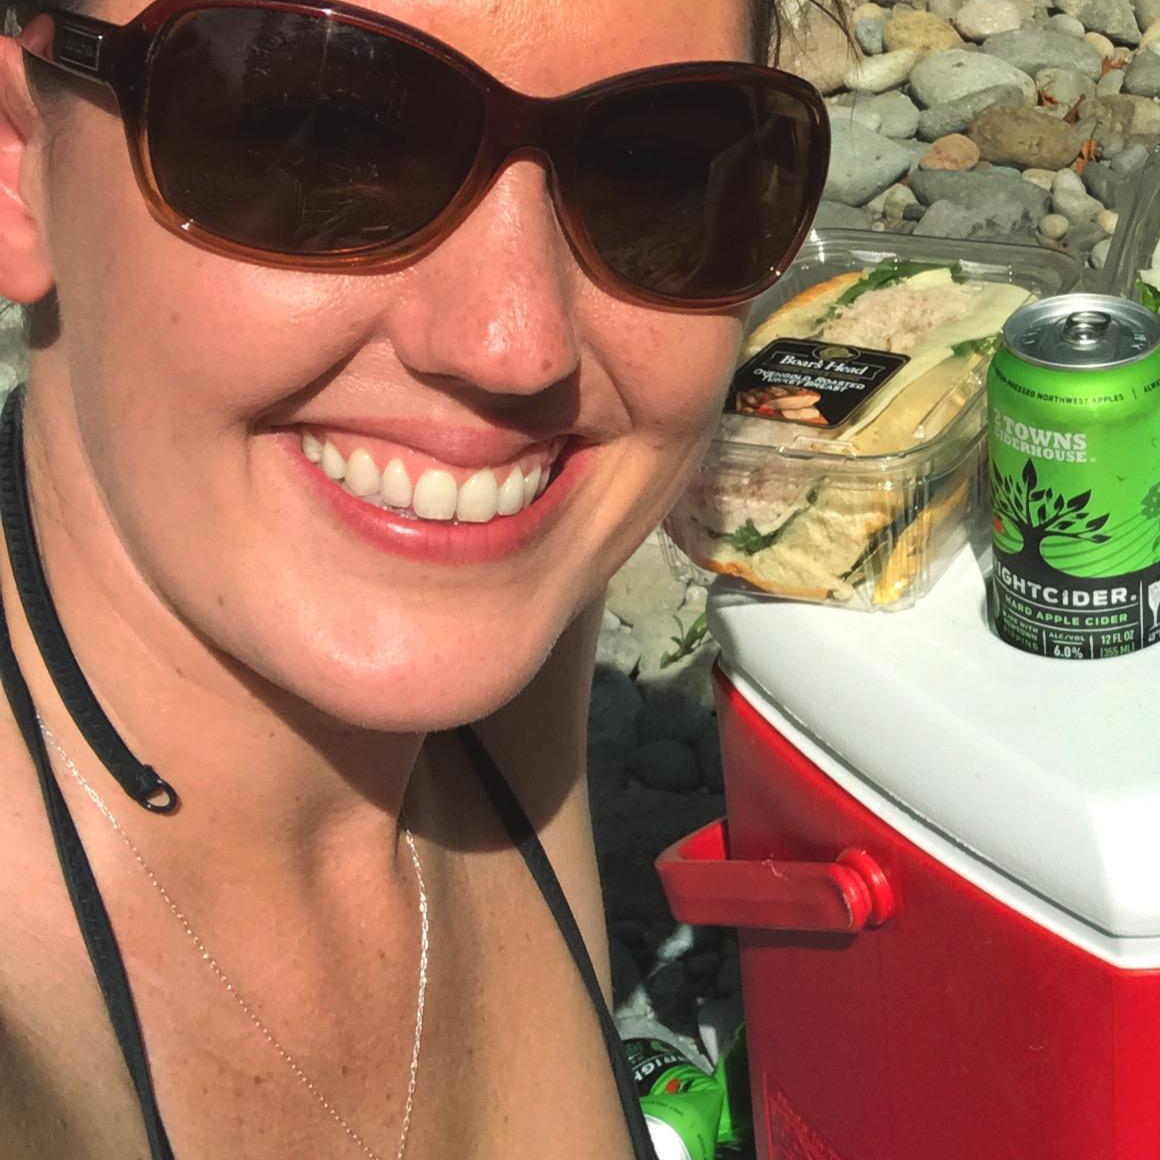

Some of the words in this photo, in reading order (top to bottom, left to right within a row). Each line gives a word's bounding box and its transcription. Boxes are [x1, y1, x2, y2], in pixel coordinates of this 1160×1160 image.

[824, 361, 869, 375] Head
[1037, 393, 1089, 405] NORTHWEST
[1092, 393, 1125, 404] APPLES
[1003, 415, 1087, 450] TOWNS
[993, 426, 1087, 463] CIDERHOUSE
[1004, 594, 1033, 616] HARD
[1036, 610, 1080, 626] APPLE
[1084, 613, 1128, 626] CIDER
[1101, 634, 1111, 645] 12
[1112, 632, 1123, 643] FL
[1124, 629, 1135, 641] OZ
[1053, 644, 1083, 659] 6.0%
